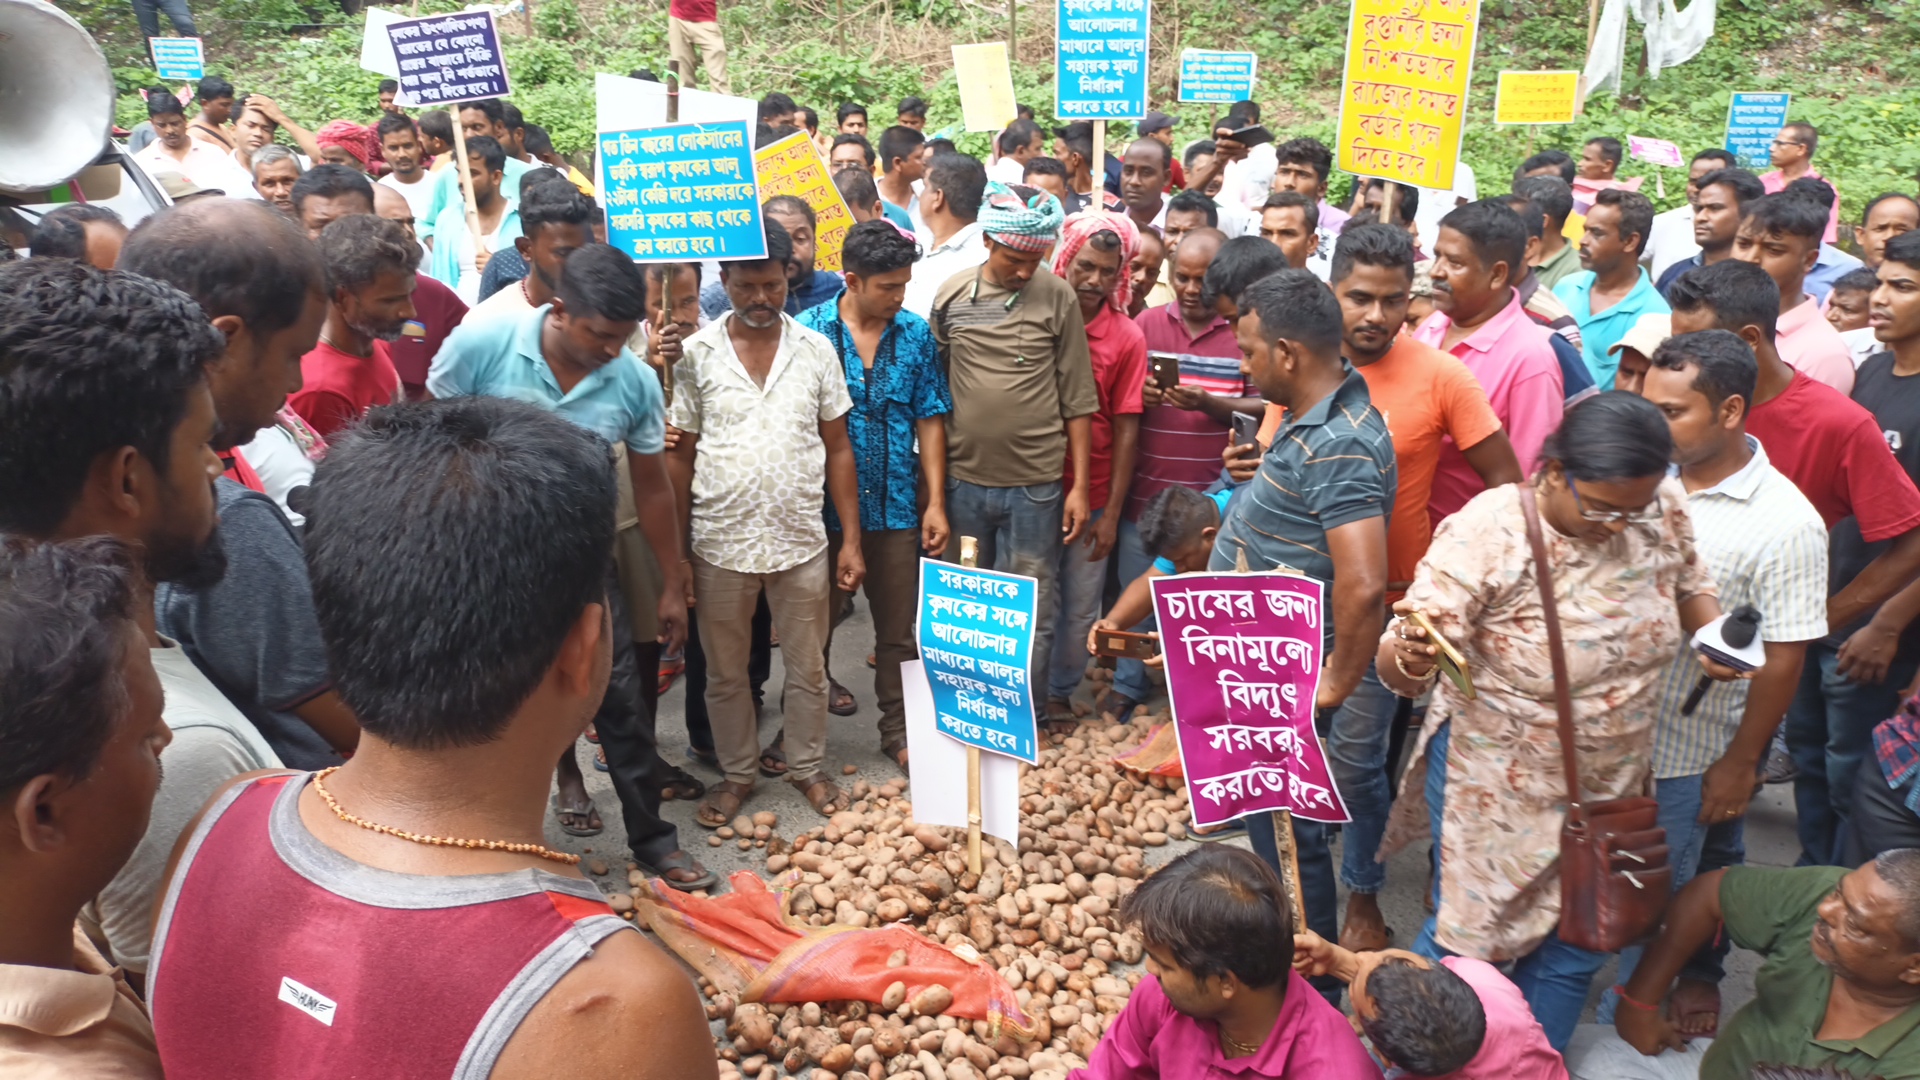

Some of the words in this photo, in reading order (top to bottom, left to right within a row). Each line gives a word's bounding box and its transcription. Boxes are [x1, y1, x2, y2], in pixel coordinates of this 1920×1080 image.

[1066, 18, 1138, 33] আলোচনার
[1431, 21, 1464, 50] জন্য
[1059, 38, 1104, 54] মাধ্যমে
[1106, 38, 1144, 57] আলুর
[1064, 59, 1110, 75] সহায়ক
[466, 82, 490, 96] হবে
[1078, 75, 1124, 94] নির্ধারণ
[1060, 100, 1101, 114] করতে
[1102, 100, 1130, 116] হবে
[1418, 89, 1458, 118] সমস্ত
[1408, 120, 1441, 152] খুলে
[666, 159, 710, 182] কৃষকের
[711, 156, 744, 180] আলু
[1352, 137, 1392, 169] দিতে
[1397, 152, 1425, 180] হবে
[692, 183, 755, 202] সরকারকে
[646, 212, 688, 234] কৃষকের
[688, 210, 716, 230] কাছ
[716, 208, 752, 227] থেকে
[654, 238, 688, 254] করতে
[688, 236, 716, 255] হবে
[938, 569, 1020, 599] সরকারকে
[926, 593, 988, 622] কৃষকের
[992, 606, 1029, 630] সঙ্গে
[1161, 588, 1255, 620] চাষের
[1261, 590, 1317, 628] জন্য
[930, 621, 1017, 656] আলোচনার
[1180, 624, 1313, 674] বিনামূল্যে
[922, 646, 976, 672] মাধ্যমে
[978, 658, 1025, 688] আলুর
[934, 670, 987, 694] সহায়ক
[990, 684, 1021, 706] মূল্য
[1216, 669, 1297, 720] বিদ্যুৎ
[955, 689, 1008, 724] নির্ধারণ
[939, 711, 982, 740] করতে
[985, 728, 1017, 750] হবে
[1193, 767, 1286, 806] করতে
[1288, 771, 1336, 810] হবে
